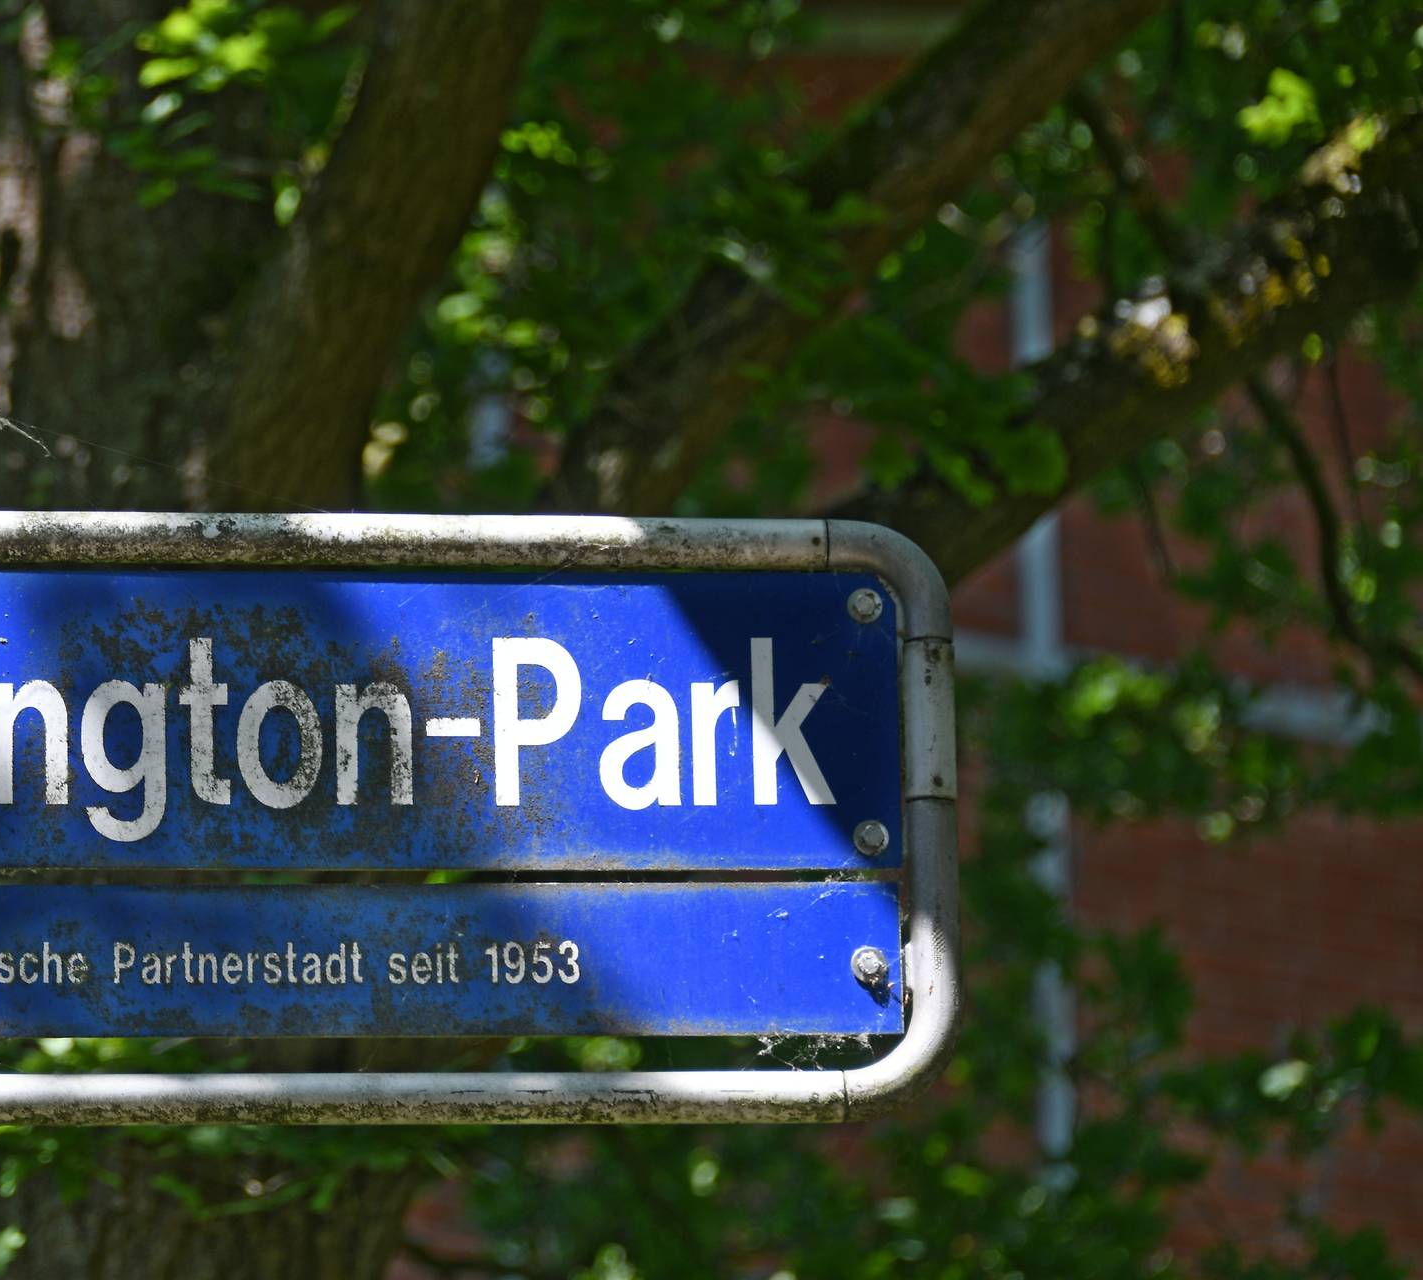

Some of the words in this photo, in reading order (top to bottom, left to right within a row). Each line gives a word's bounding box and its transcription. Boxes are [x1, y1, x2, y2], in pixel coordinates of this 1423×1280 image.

[113, 941, 365, 985] Partnerstadt
[388, 942, 461, 985] seit
[484, 940, 581, 985] 1953
